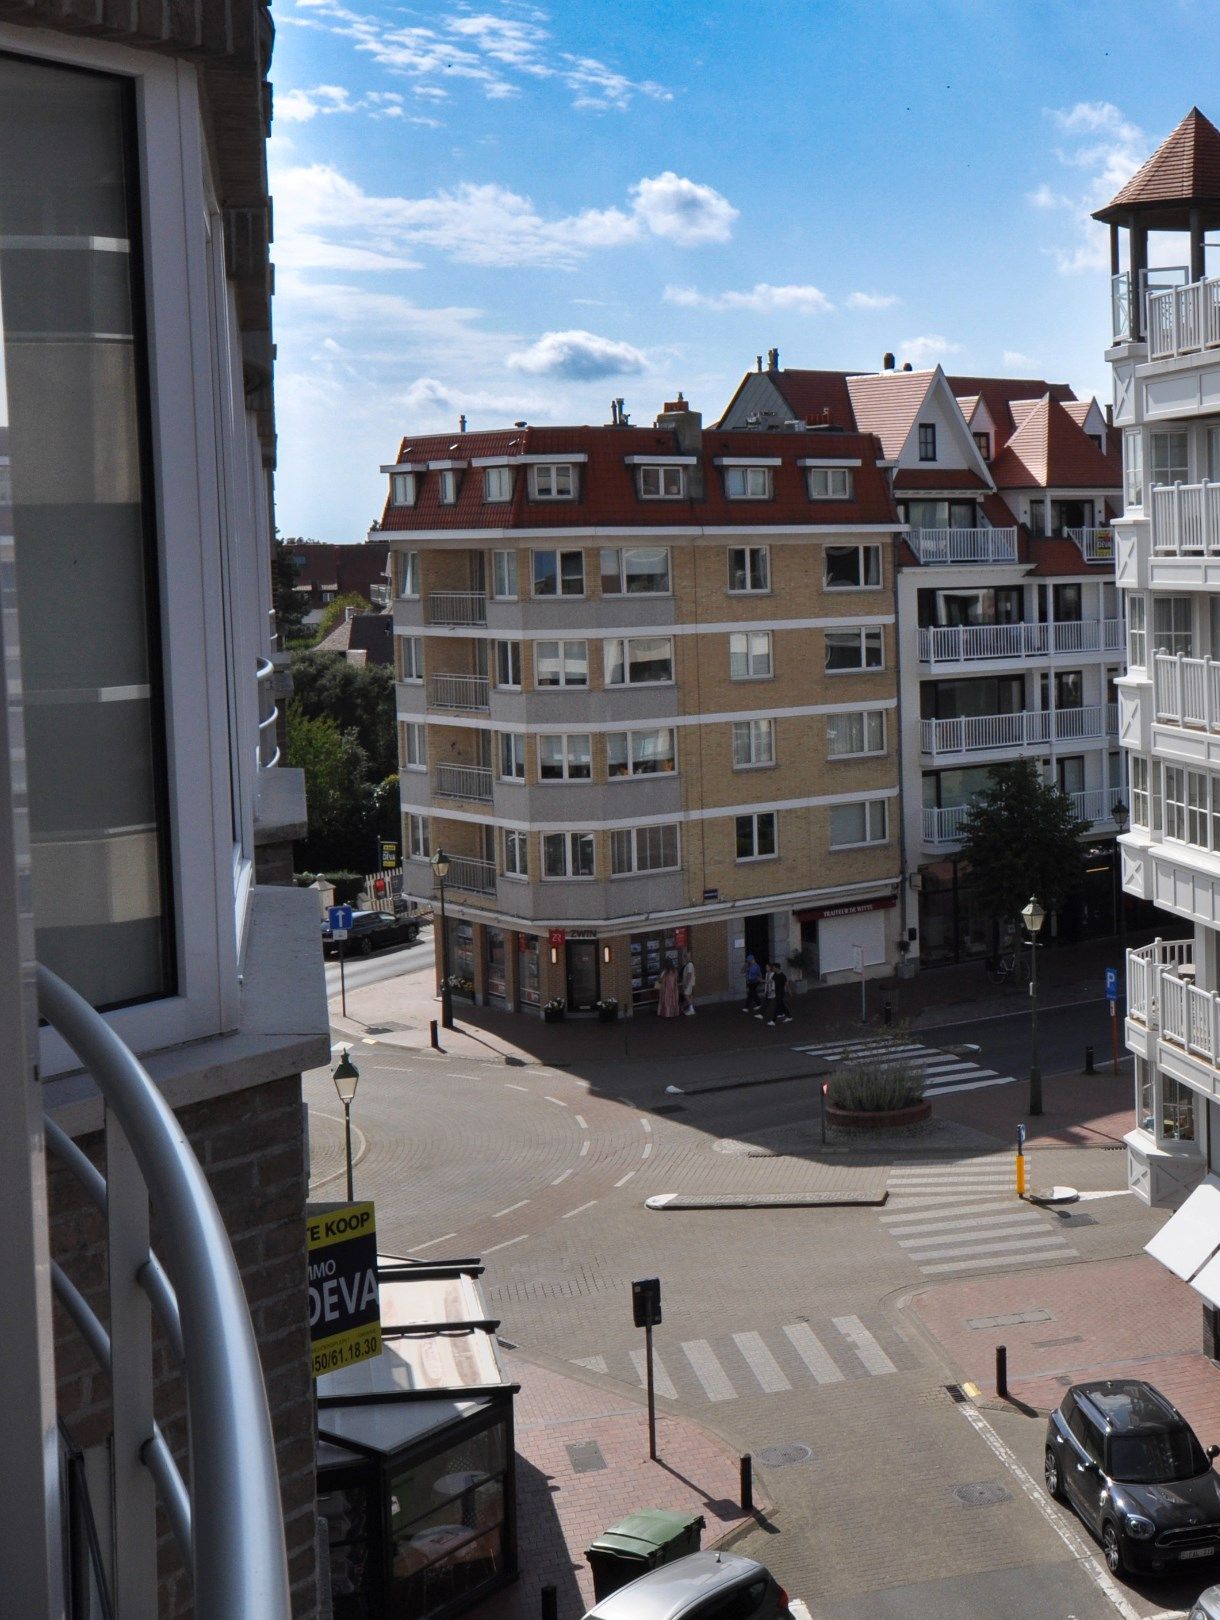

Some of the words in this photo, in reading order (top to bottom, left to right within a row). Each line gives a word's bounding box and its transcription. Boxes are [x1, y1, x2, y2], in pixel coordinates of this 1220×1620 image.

[570, 929, 598, 938] ZWIN
[1106, 972, 1116, 988] P
[307, 1224, 321, 1242] E
[325, 1211, 370, 1238] KOOP
[312, 1336, 377, 1372] 50/61.18.30
